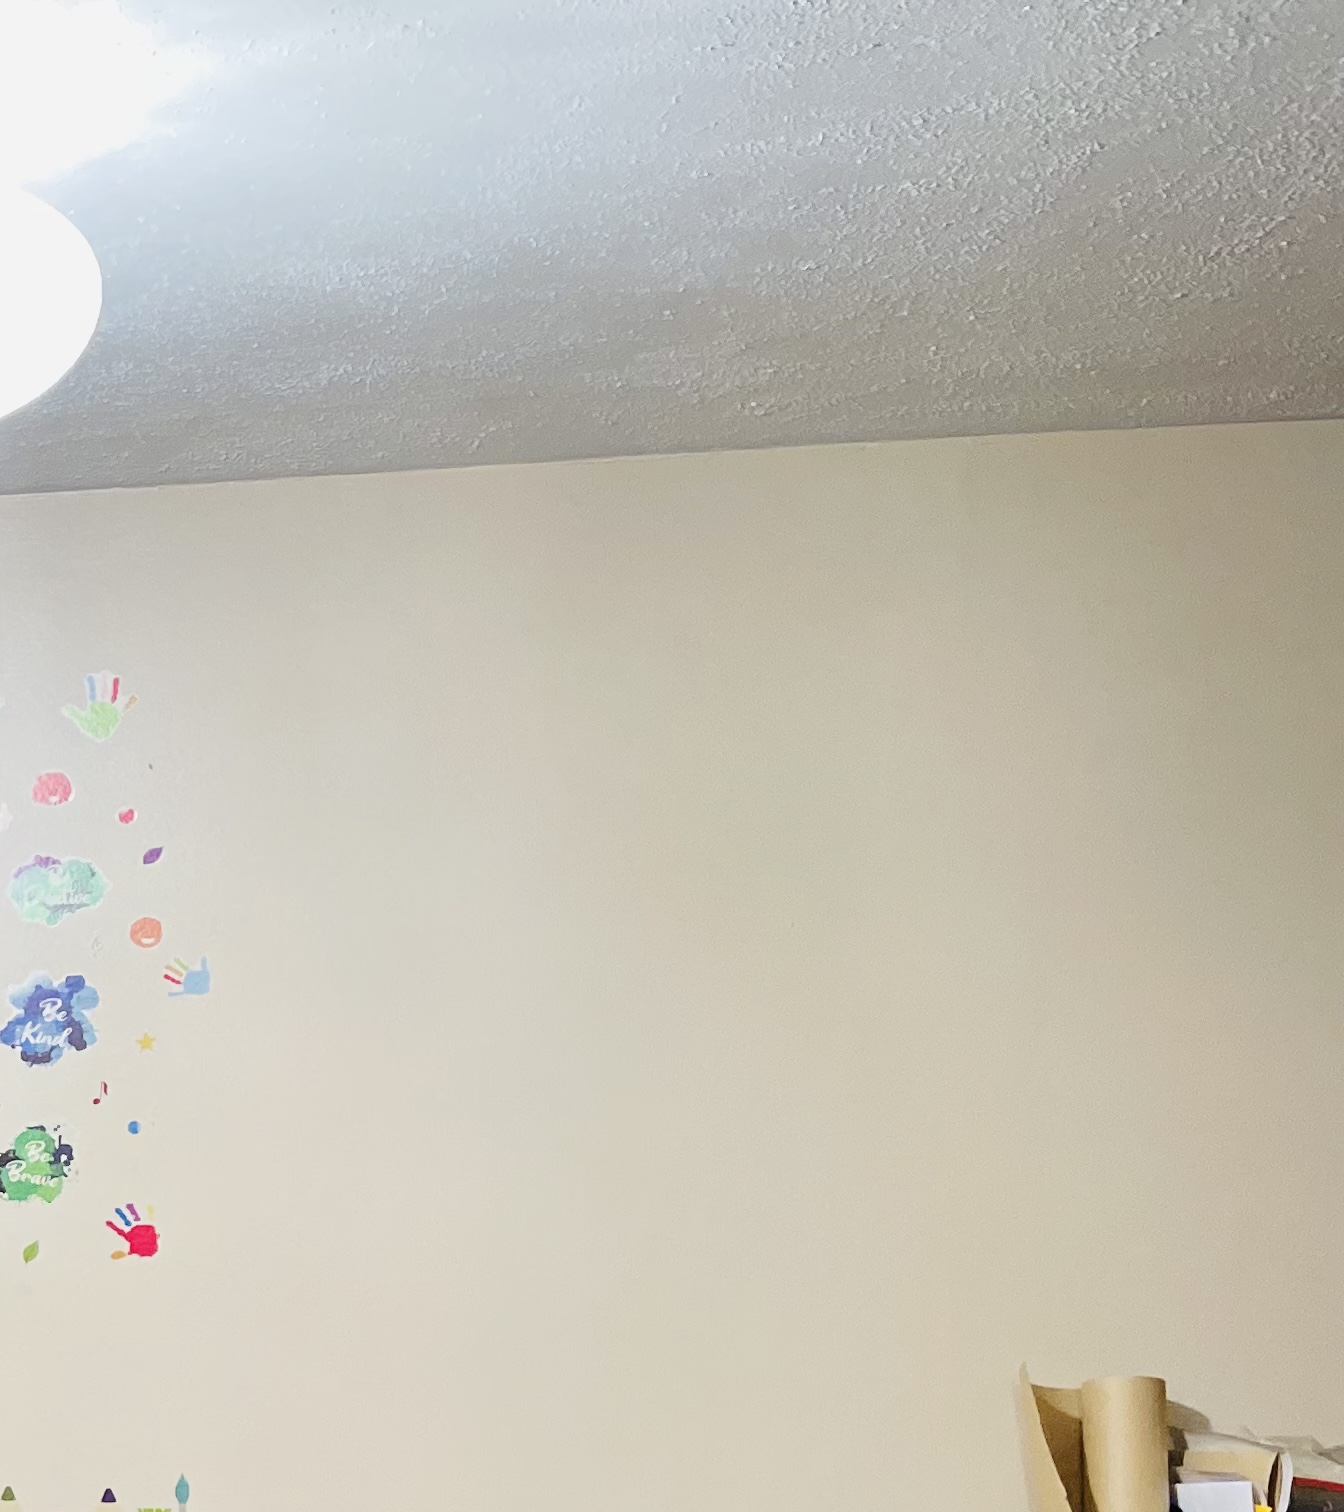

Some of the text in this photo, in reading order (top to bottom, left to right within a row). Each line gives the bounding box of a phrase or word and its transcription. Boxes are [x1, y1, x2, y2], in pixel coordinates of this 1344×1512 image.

[38, 997, 68, 1023] Be
[20, 1020, 73, 1048] Kind
[24, 1140, 55, 1163] Be
[5, 1160, 60, 1188] Brave
